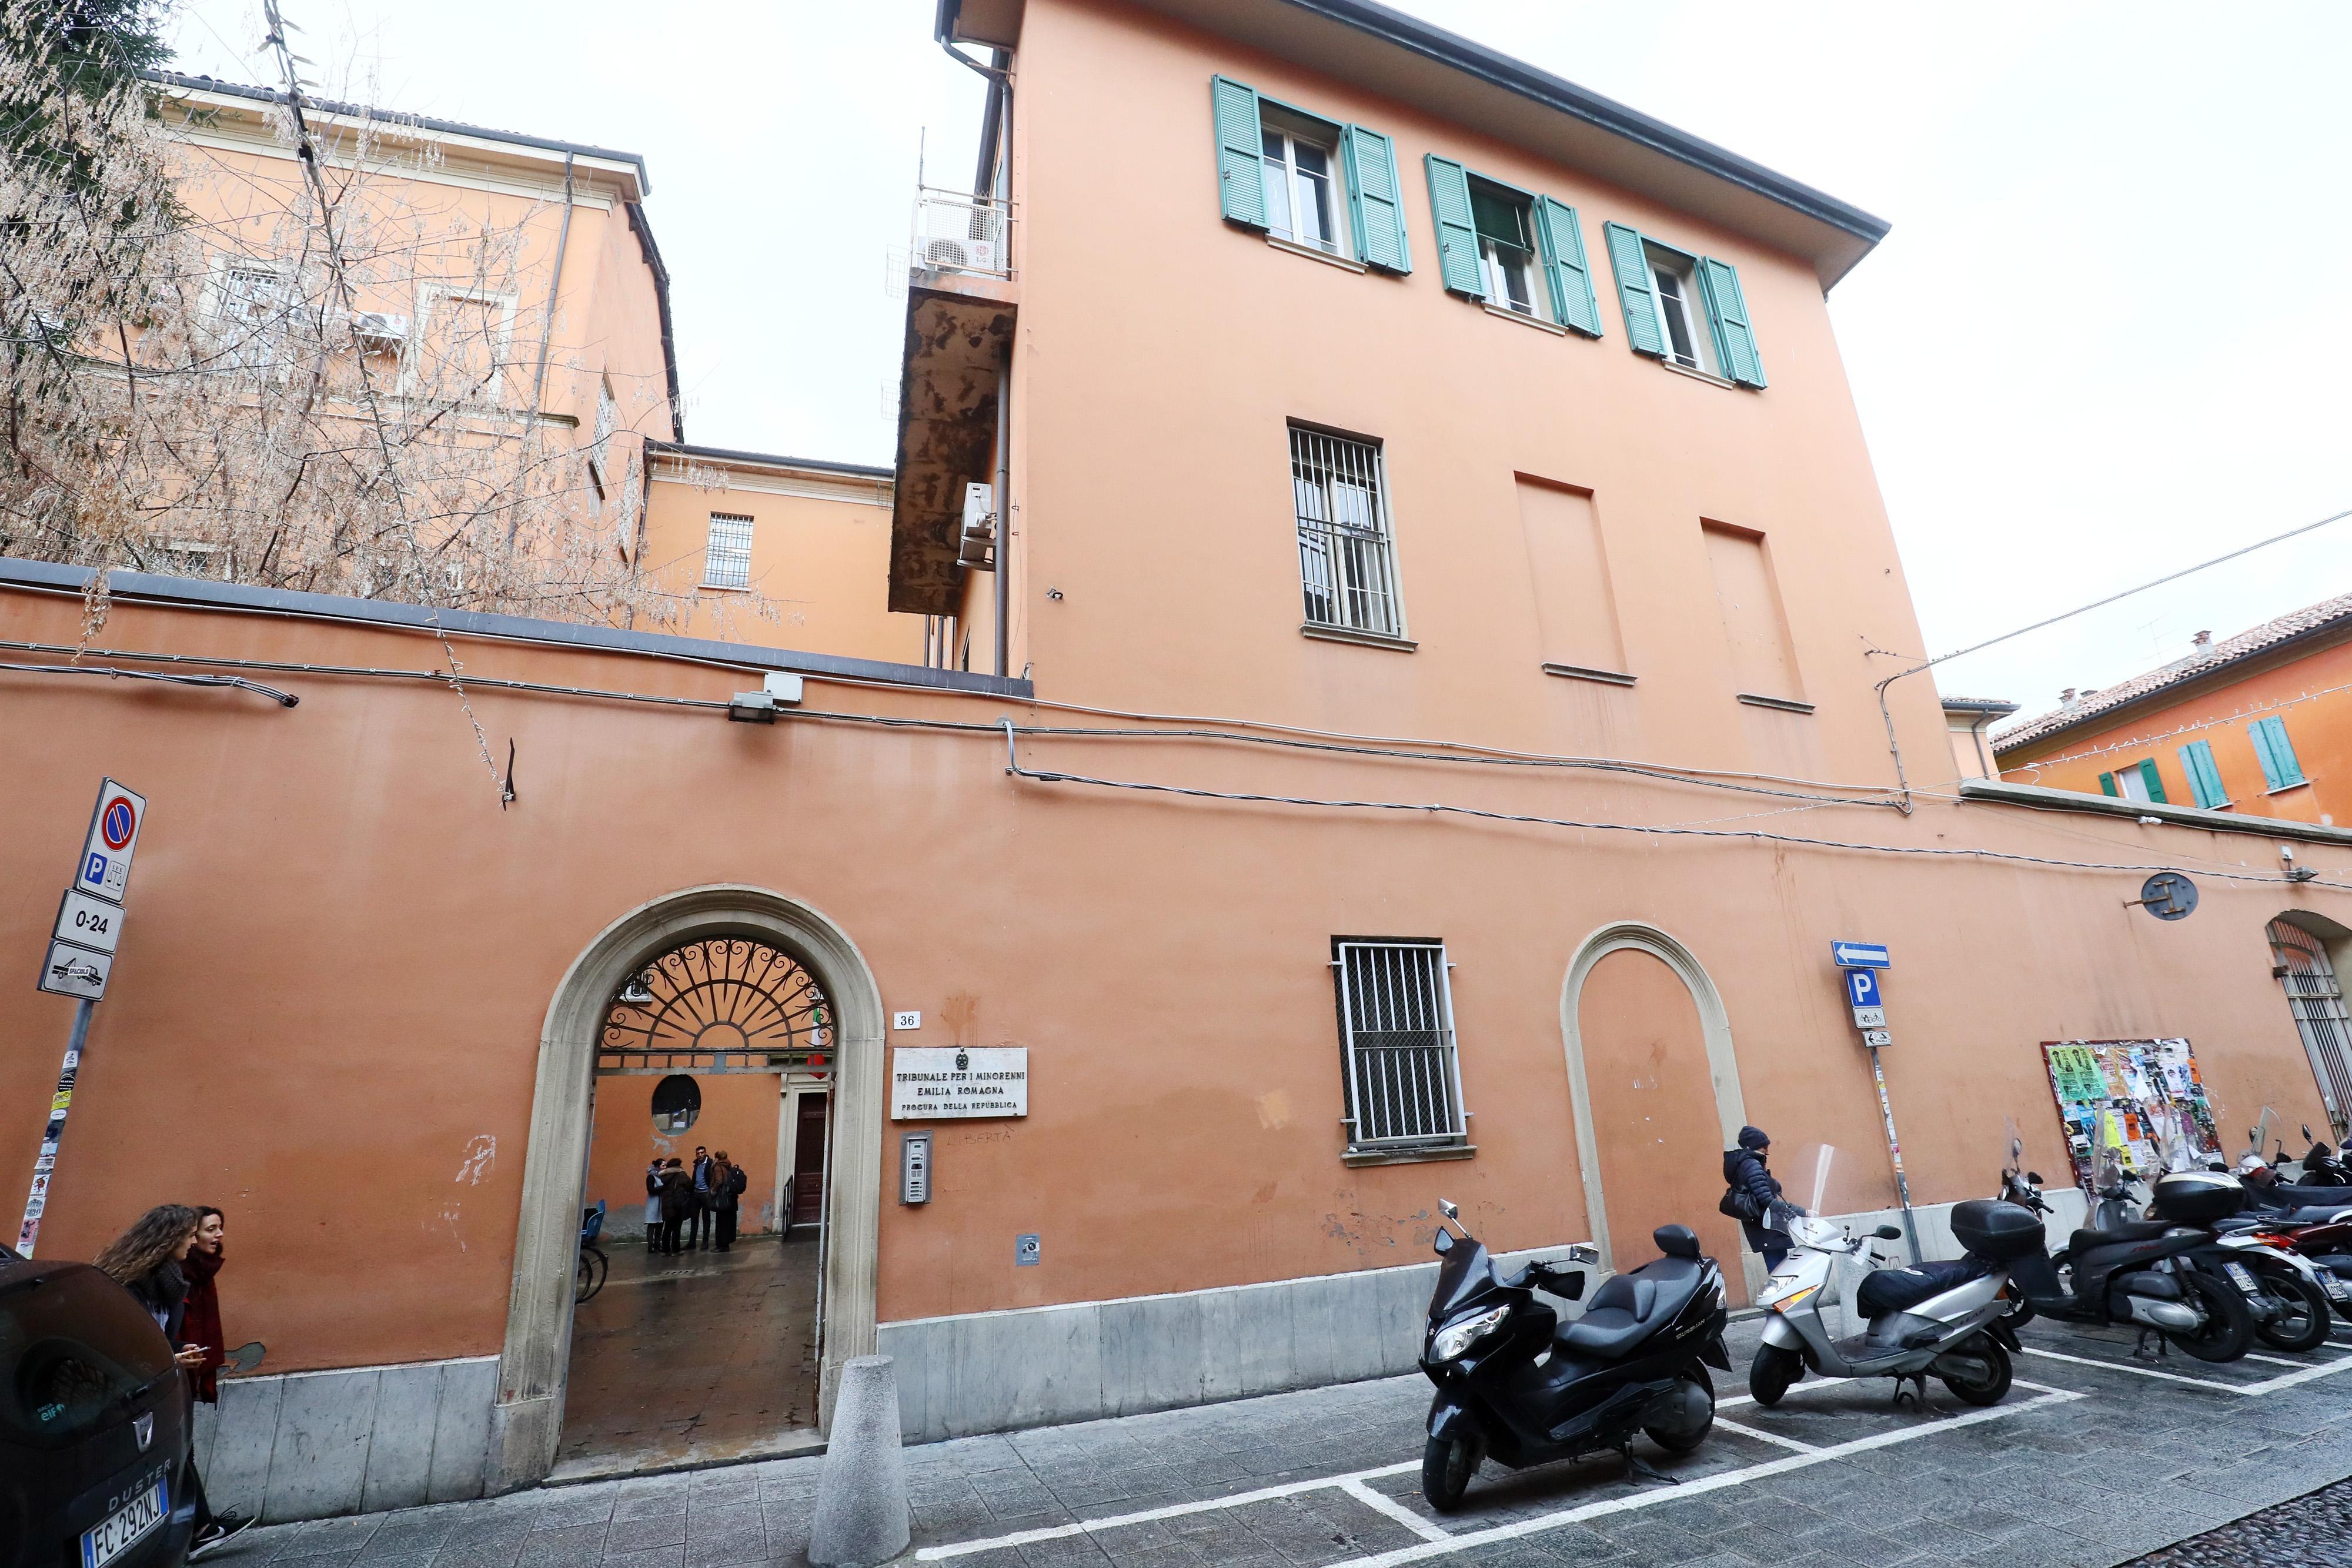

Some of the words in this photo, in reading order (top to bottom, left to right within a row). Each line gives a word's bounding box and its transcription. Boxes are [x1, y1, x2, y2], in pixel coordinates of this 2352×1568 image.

[89, 857, 103, 878] P
[112, 864, 123, 874] LEX
[75, 910, 109, 935] 0-24
[1853, 973, 1872, 1003] P
[900, 1015, 914, 1026] 36
[897, 1073, 947, 1082] TRIBUNALE
[951, 1072, 967, 1081] PER
[975, 1072, 1025, 1081] MINORENNI
[917, 1088, 951, 1096] EMILIA
[957, 1086, 1004, 1095] ROMAGNA
[947, 1124, 1015, 1146] LIBERTÀ
[1675, 1319, 1705, 1340] BURGMAN
[41, 1407, 57, 1421] elf
[109, 1458, 171, 1513] DUSTER
[94, 1523, 115, 1564] FC
[119, 1486, 160, 1546] 292NJ
